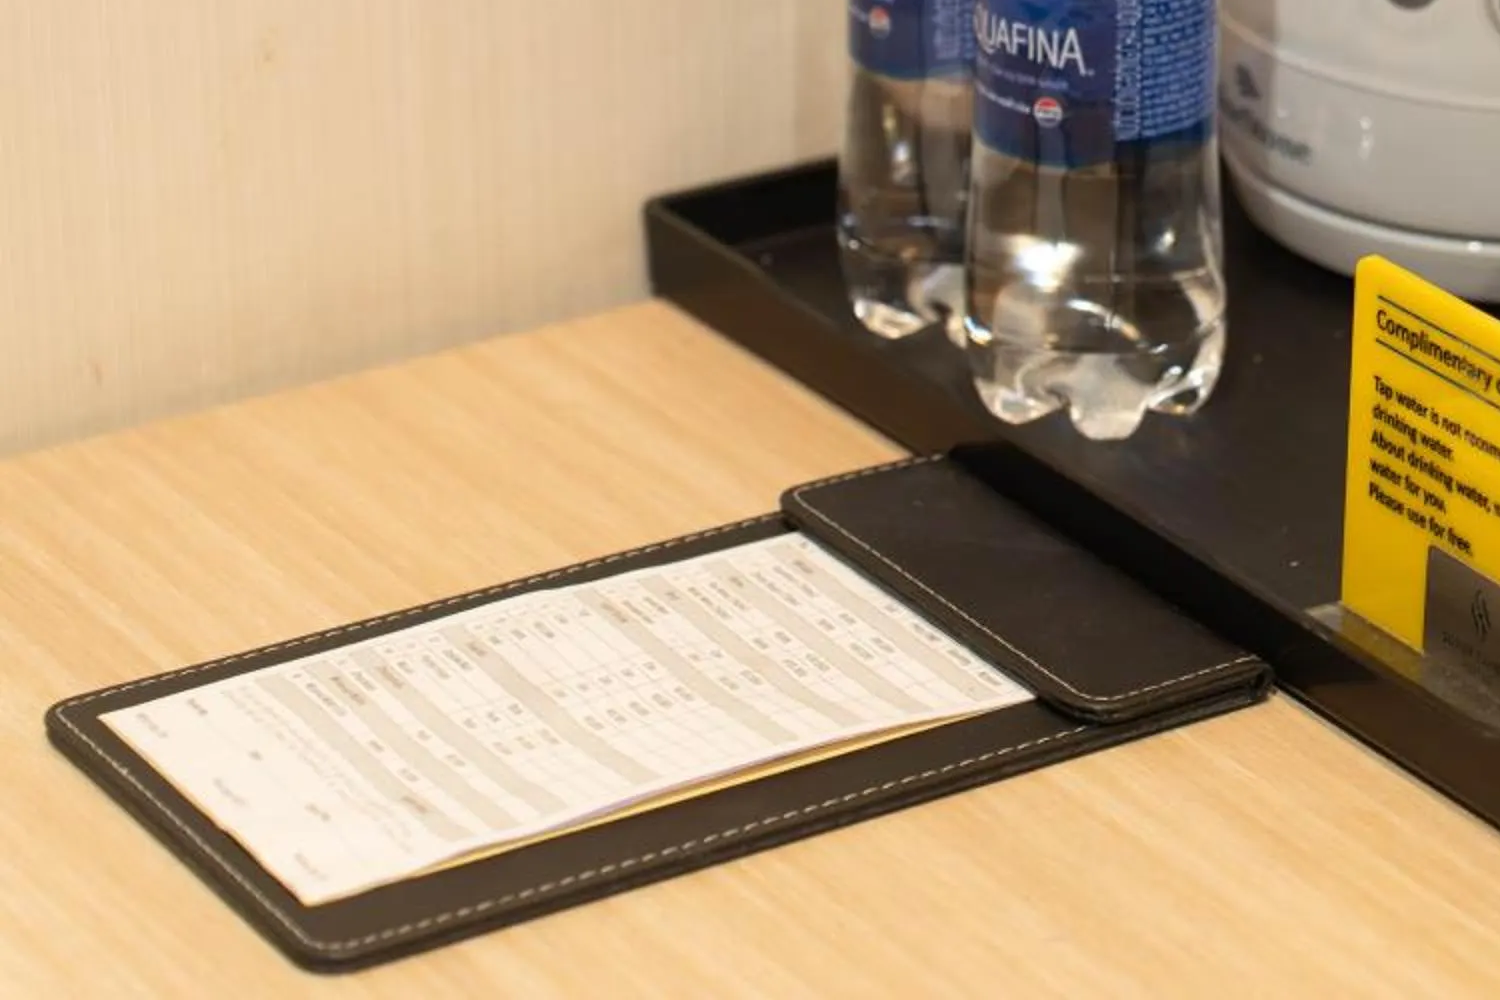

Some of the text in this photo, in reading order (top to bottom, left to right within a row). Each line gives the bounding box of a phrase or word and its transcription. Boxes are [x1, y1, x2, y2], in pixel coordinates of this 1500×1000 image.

[1375, 308, 1493, 393] Complimentary
[1372, 403, 1418, 446] drinking
[1373, 375, 1393, 401] Tap
[1395, 391, 1429, 418] water
[1430, 407, 1440, 425] is
[1441, 416, 1462, 439] not
[1369, 458, 1402, 487] water
[1404, 475, 1421, 497] for
[1371, 429, 1406, 462] About
[1407, 450, 1454, 494] drinking
[1368, 480, 1406, 516] Please
[1407, 507, 1427, 529] use
[1428, 515, 1446, 538] for
